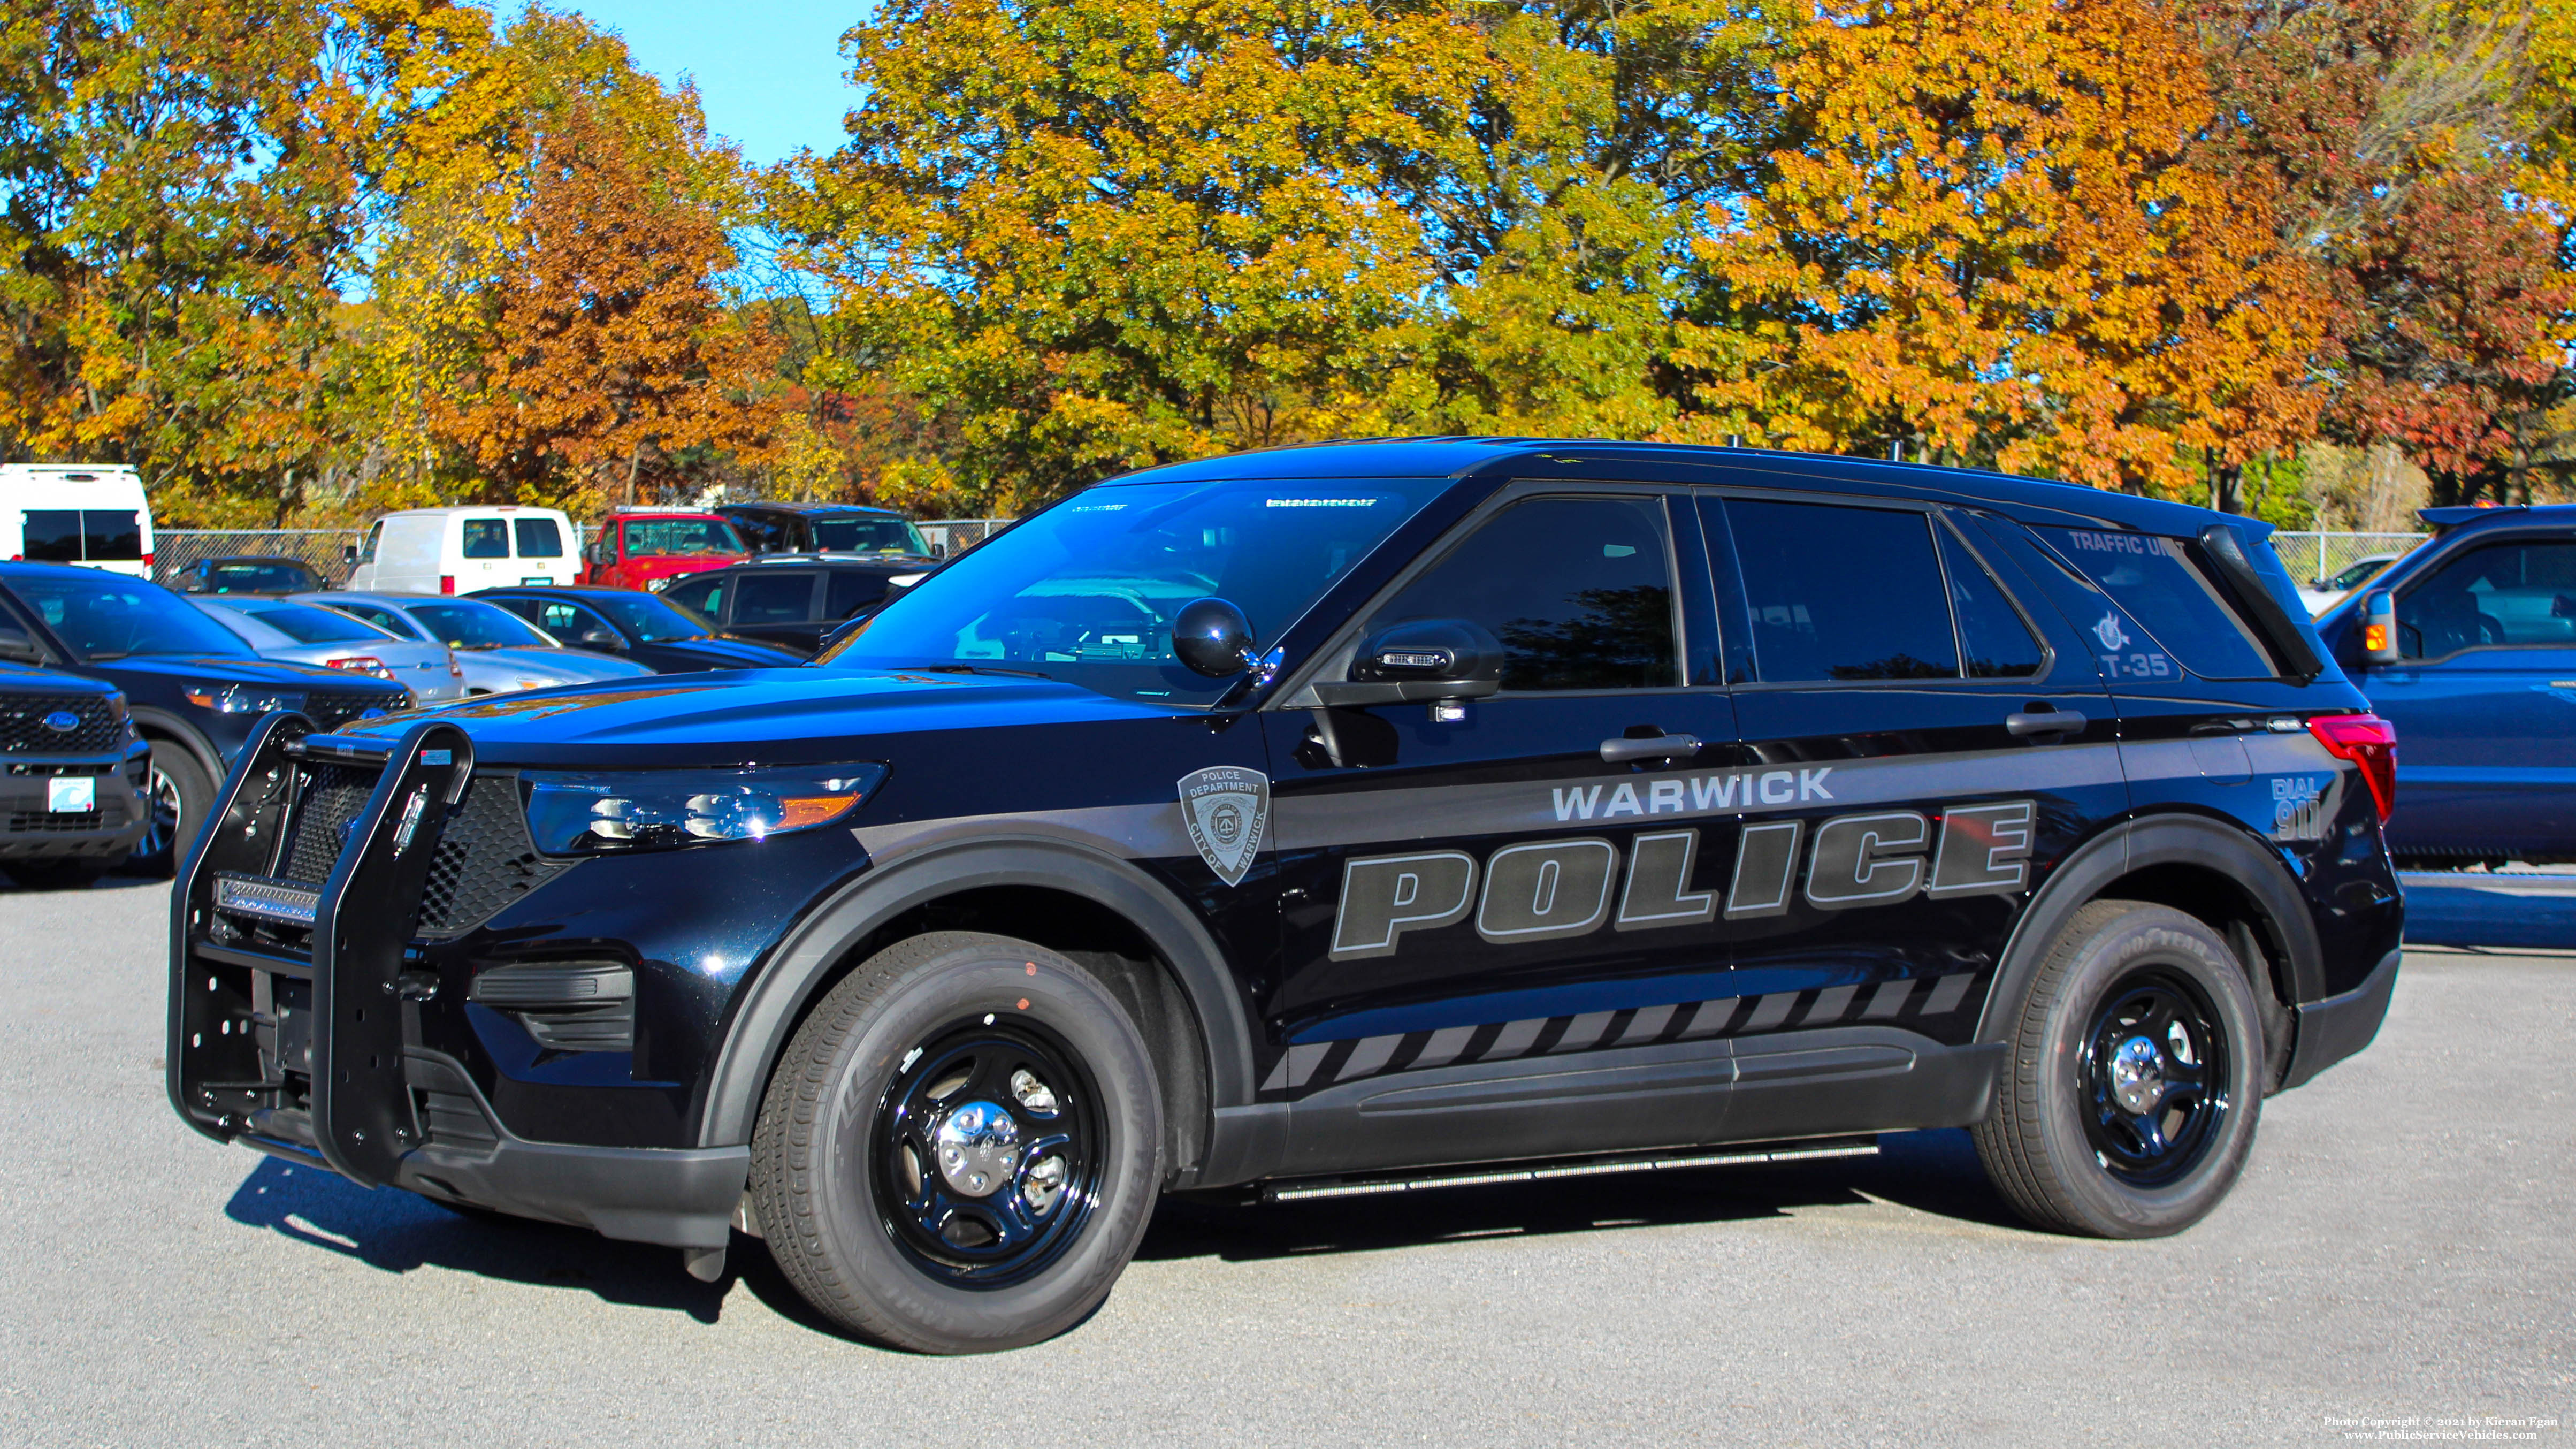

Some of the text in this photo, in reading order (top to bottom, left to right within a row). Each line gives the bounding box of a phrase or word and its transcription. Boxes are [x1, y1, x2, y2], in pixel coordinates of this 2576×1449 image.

[2068, 531, 2185, 558] TRAFFIC UNT
[2101, 654, 2169, 678] T-35
[1189, 782, 1258, 798] DEPARTMENT
[1202, 771, 1240, 782] POLICE
[2271, 777, 2320, 800] DIAL
[1553, 767, 1833, 821] WARWICK
[2275, 799, 2320, 841] 911
[1190, 823, 1209, 852] CITY
[1208, 854, 1222, 871] OF
[1238, 811, 1264, 870] WARWICK
[1328, 798, 2037, 962] POLICE
